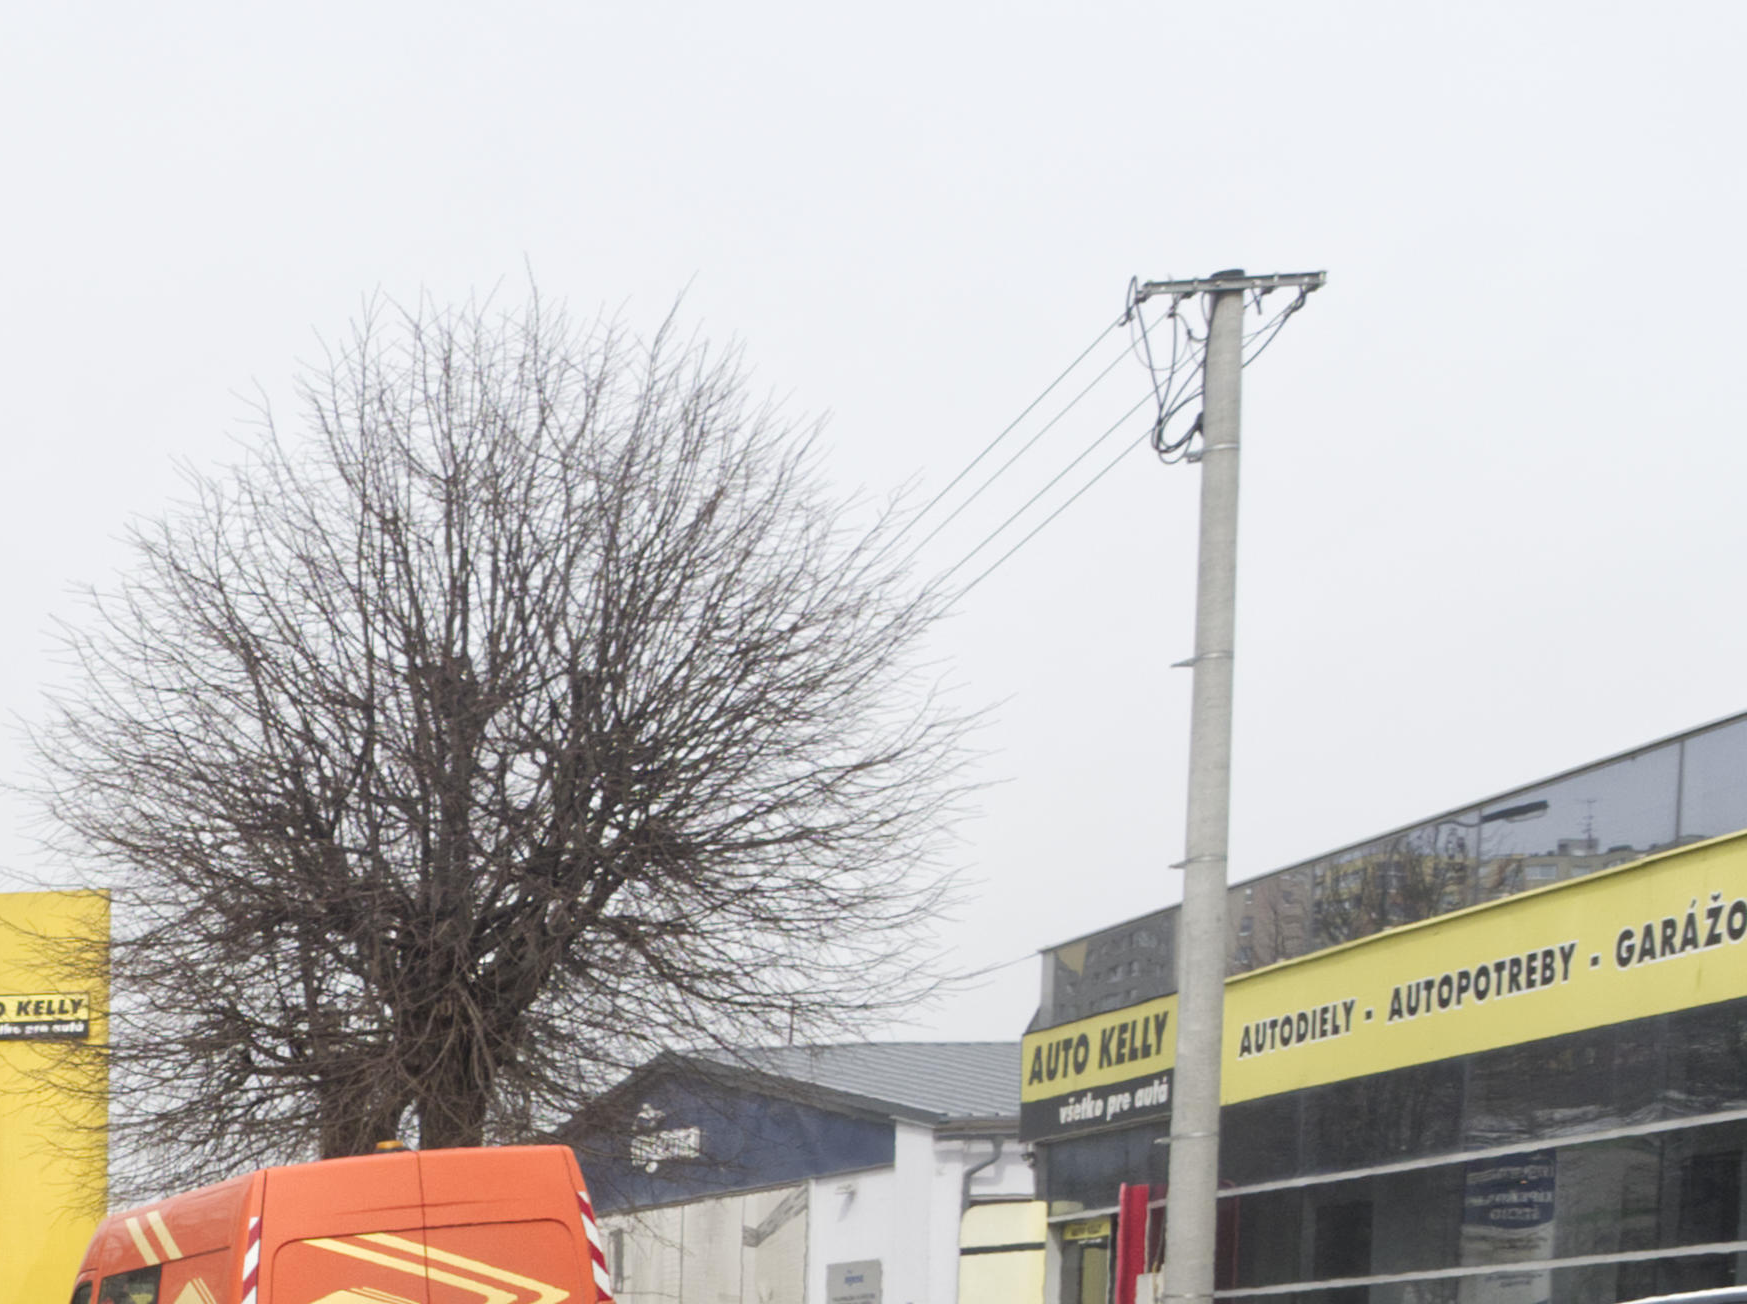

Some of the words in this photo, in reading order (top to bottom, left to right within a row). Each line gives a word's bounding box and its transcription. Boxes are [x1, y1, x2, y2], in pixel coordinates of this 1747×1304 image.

[16, 999, 84, 1016] KELLY
[1238, 998, 1358, 1059] AUTODIELY
[1387, 940, 1580, 1025] AUTOPOTREBY
[1028, 1033, 1090, 1086] AUTO
[1098, 1011, 1169, 1070] KELLY
[1059, 1091, 1104, 1124] všetko
[1106, 1091, 1132, 1121] pre
[1134, 1075, 1168, 1108] autá
